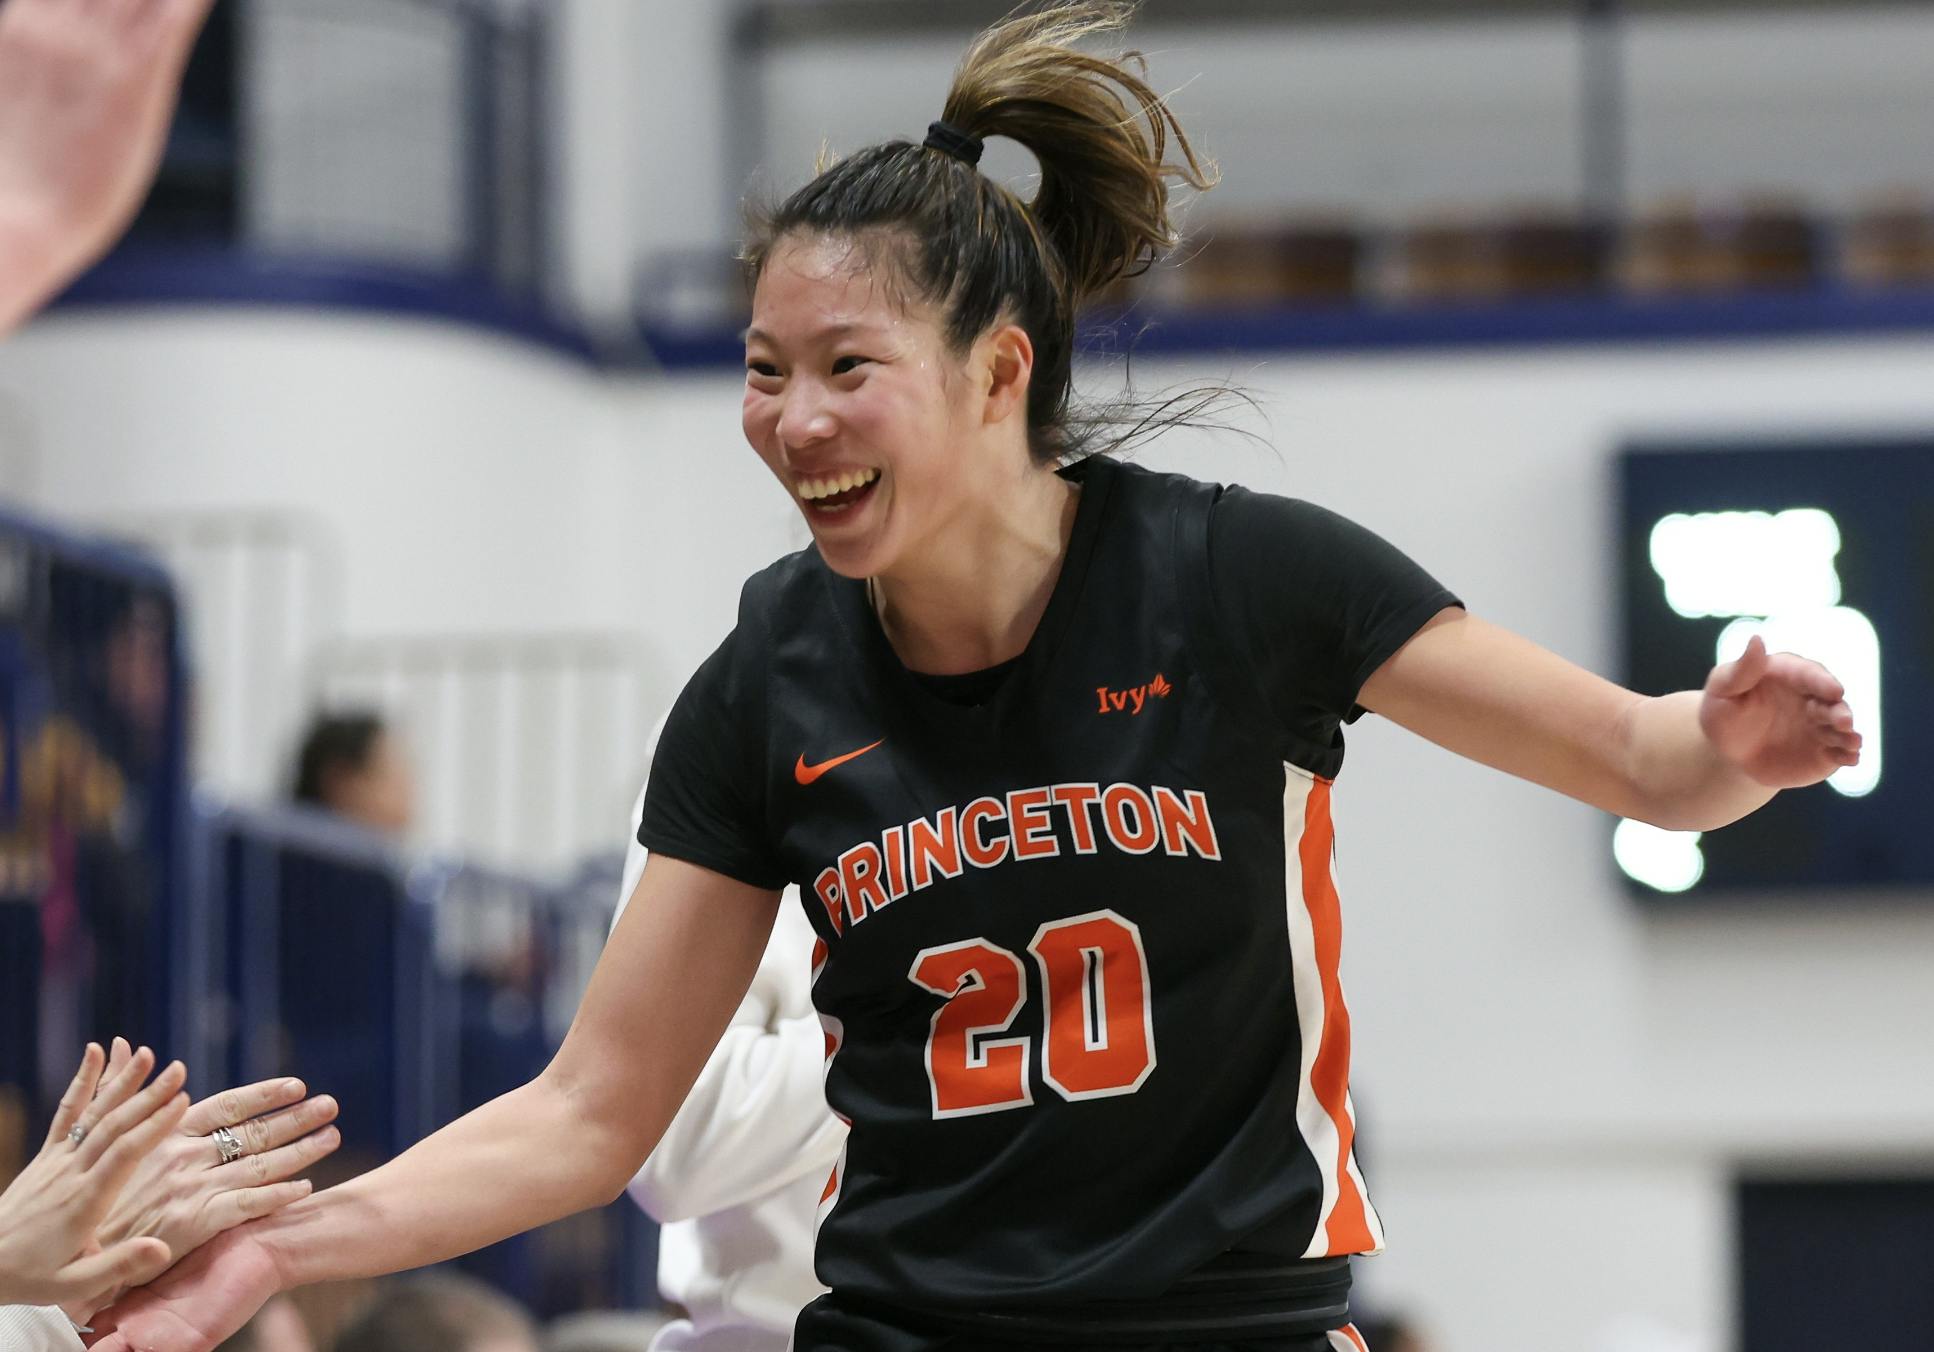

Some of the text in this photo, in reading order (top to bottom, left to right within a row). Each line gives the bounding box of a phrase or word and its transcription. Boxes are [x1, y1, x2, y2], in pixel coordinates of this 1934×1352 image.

[1096, 685, 1146, 715] Ivy
[813, 782, 1222, 938] PRINCETON
[907, 908, 1157, 1120] 20
